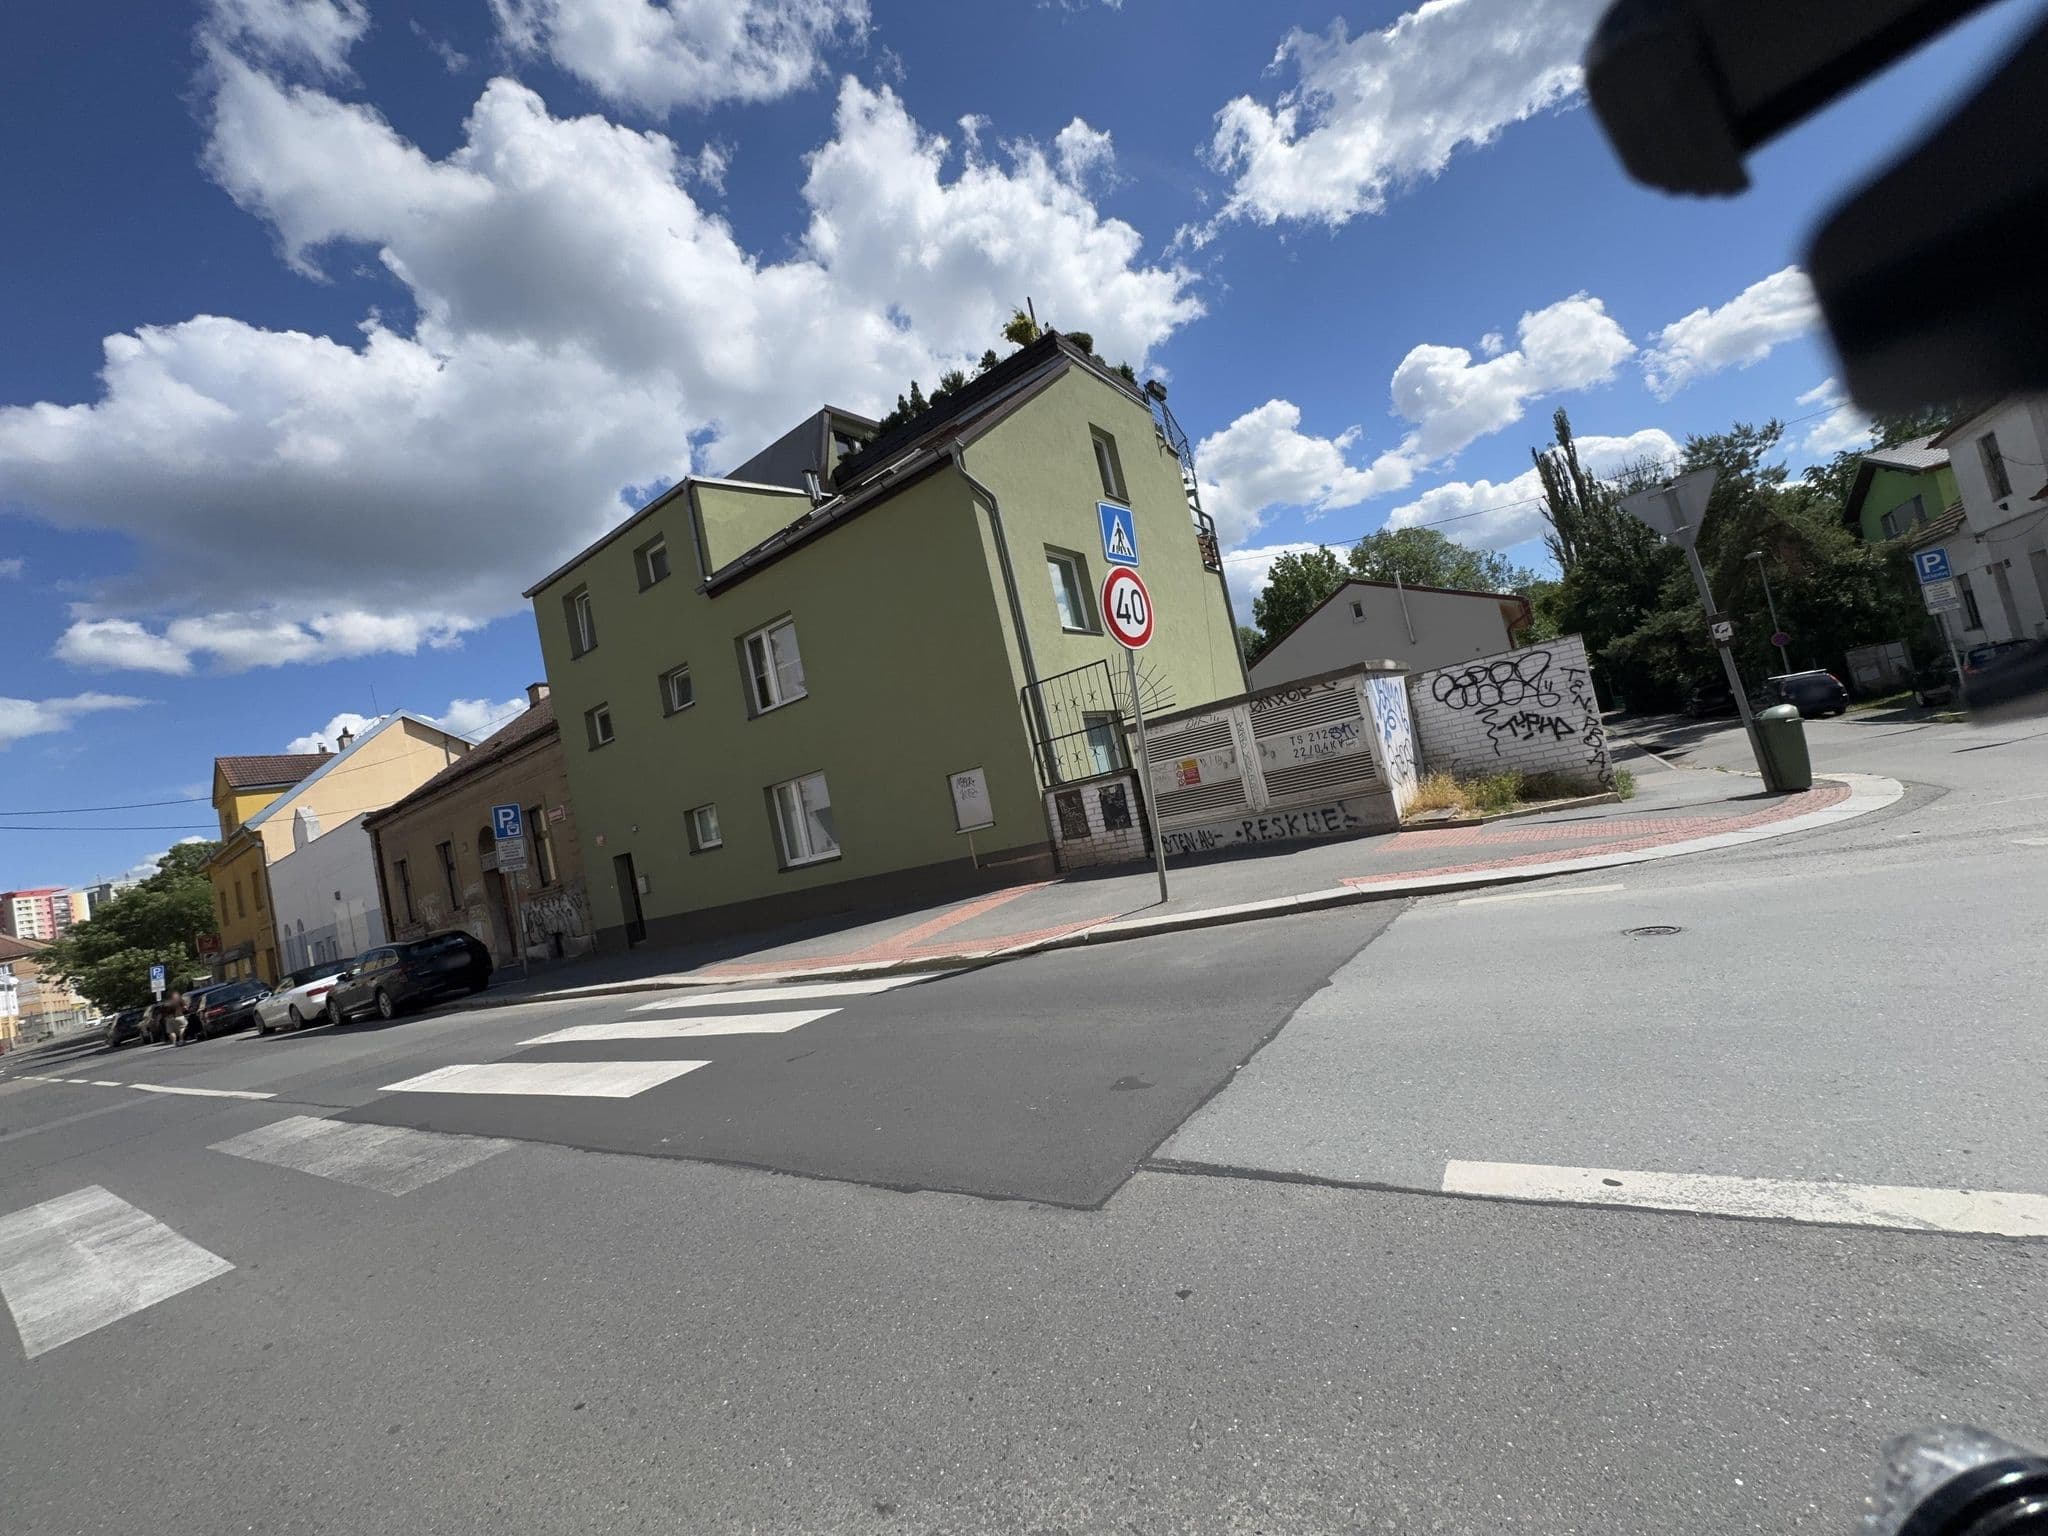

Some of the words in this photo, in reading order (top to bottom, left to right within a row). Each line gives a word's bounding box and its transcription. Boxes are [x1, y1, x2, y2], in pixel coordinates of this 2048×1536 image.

[1921, 553, 1941, 574] P
[1116, 587, 1145, 625] 40
[1290, 735, 1303, 746] TS
[498, 808, 515, 829] P
